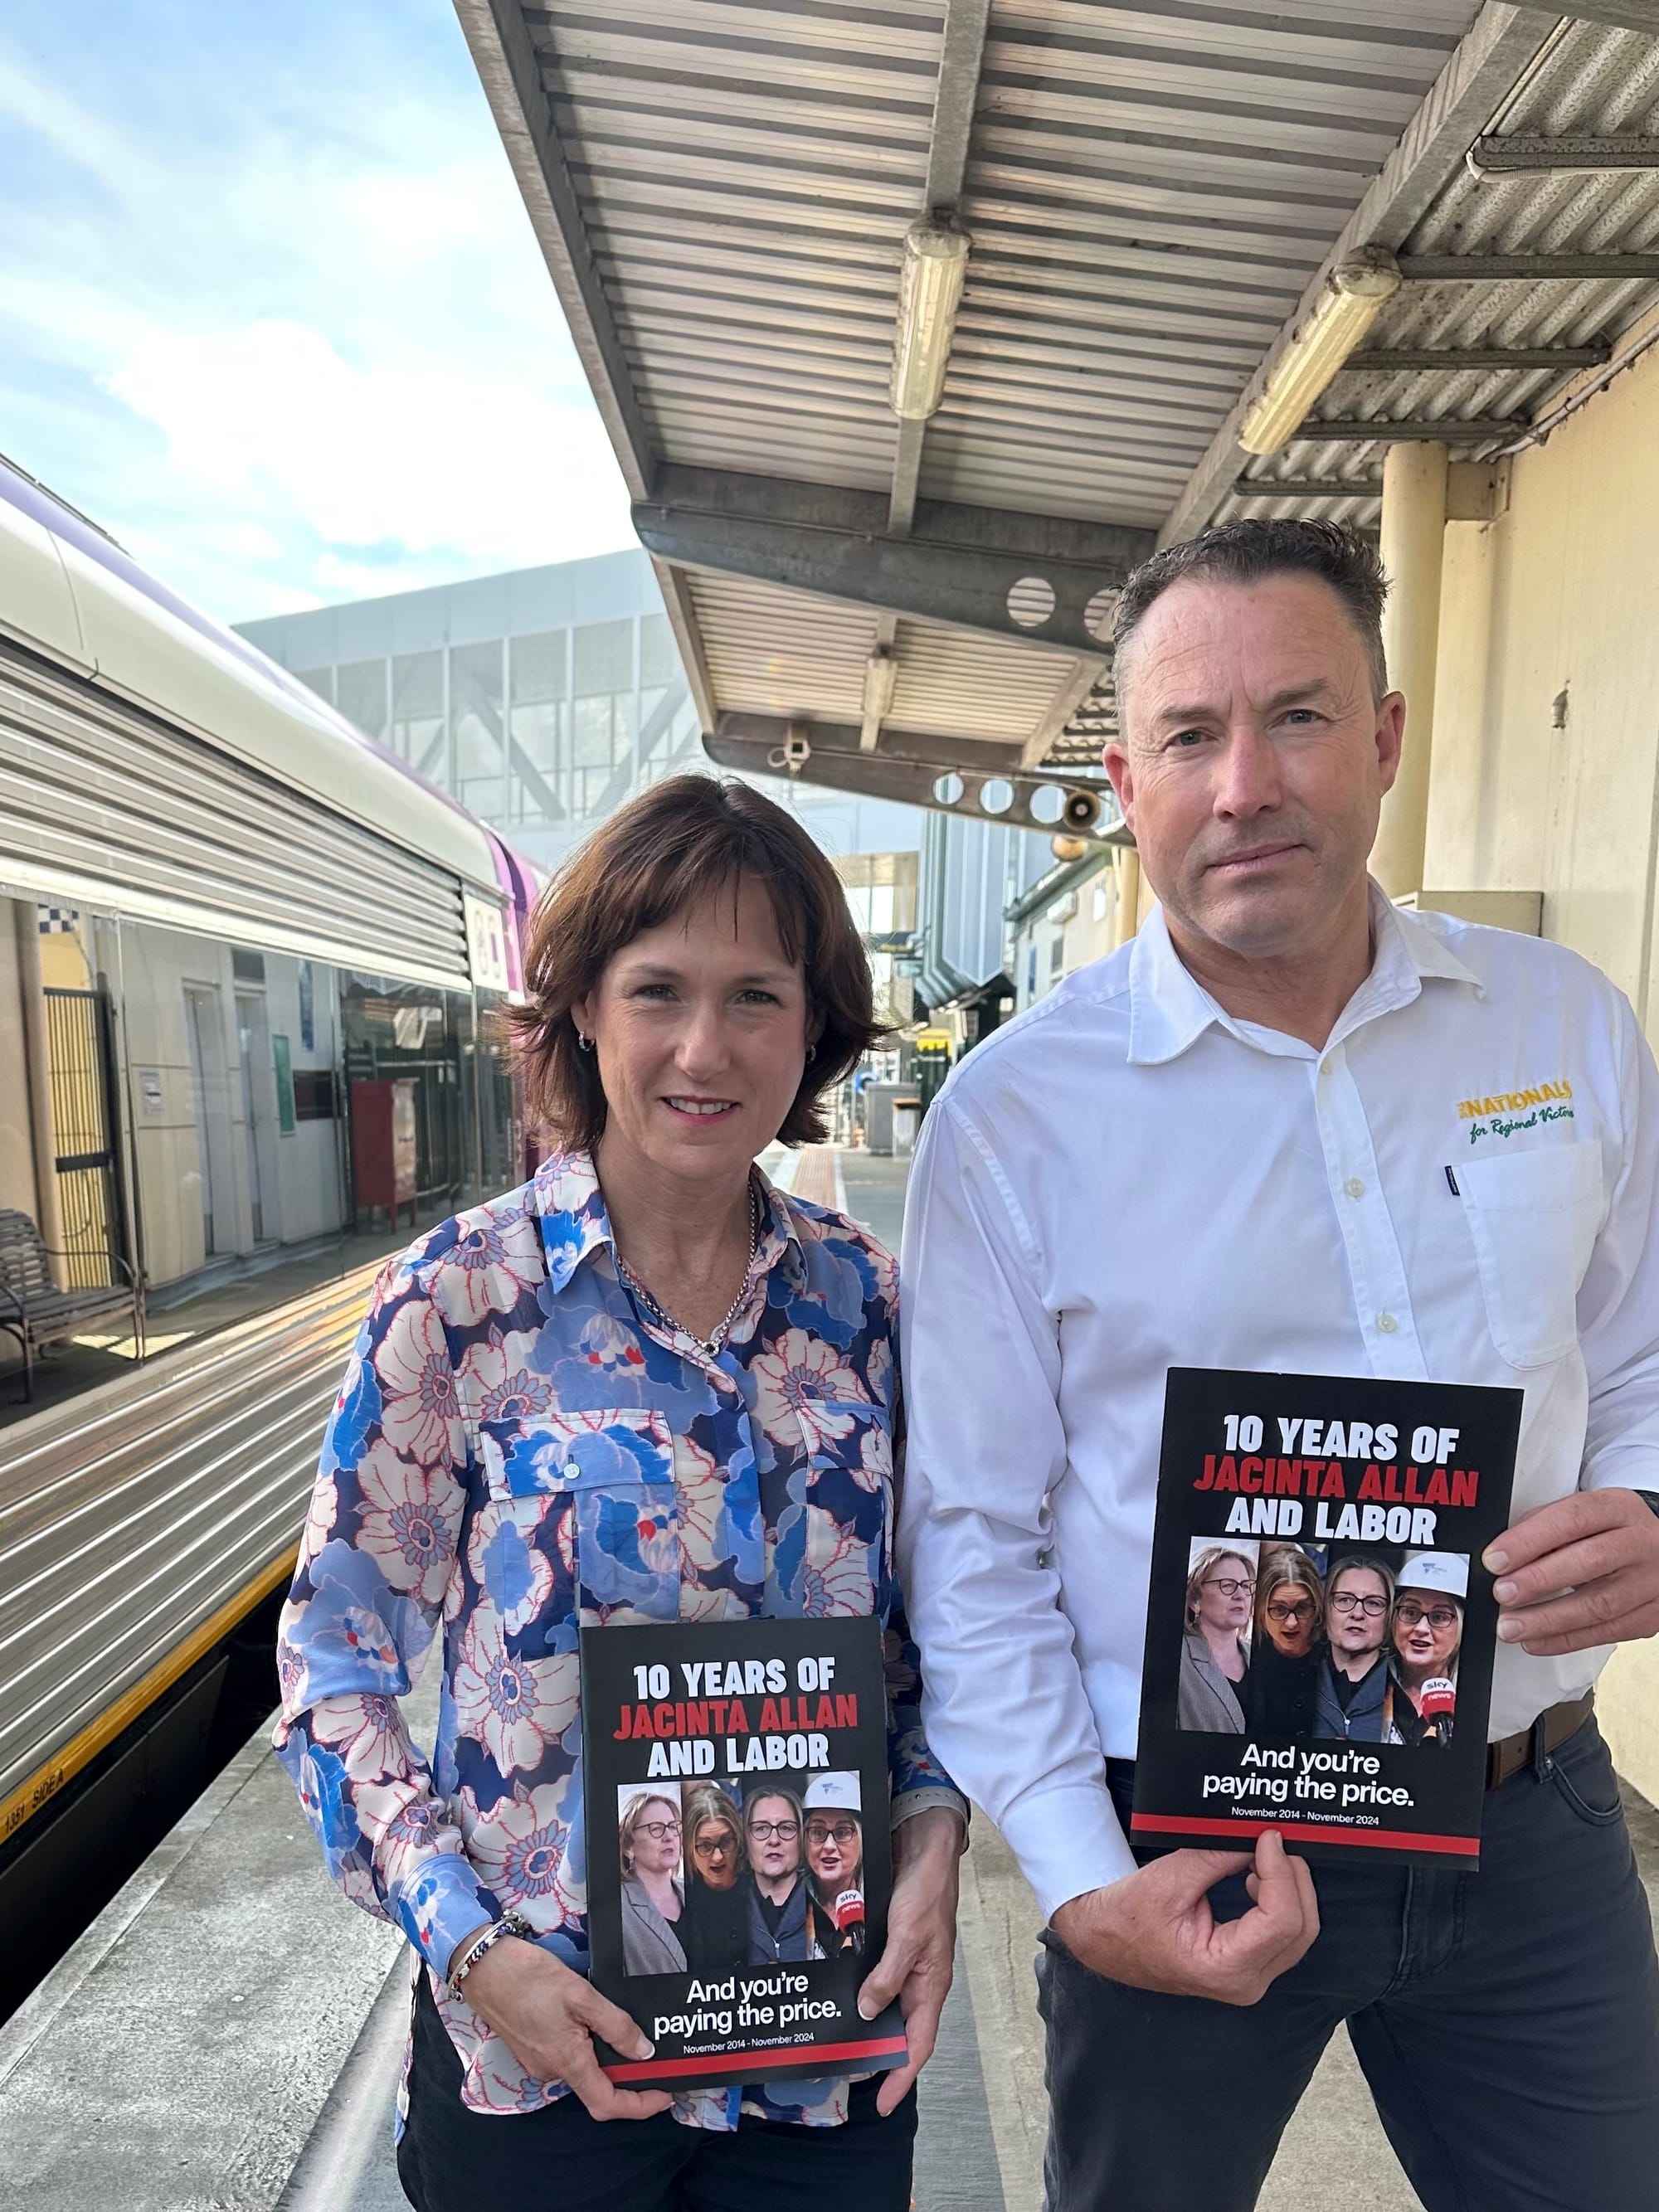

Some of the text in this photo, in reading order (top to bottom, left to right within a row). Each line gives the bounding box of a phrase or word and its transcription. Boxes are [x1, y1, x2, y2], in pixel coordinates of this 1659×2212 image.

[1470, 1123, 1488, 1145] for
[1491, 1112, 1538, 1138] Regional
[1224, 1414, 1460, 1465] 10 YEARS OF
[1194, 1455, 1479, 1507] JACINTA ALLAN
[1224, 1496, 1438, 1545] AND LABOR
[633, 1656, 835, 1700] 10 YEARS OF
[614, 1694, 858, 1740] JACINTA ALLAN
[646, 1733, 830, 1777] AND LABOR
[1239, 1743, 1380, 1776] And you're
[32, 1773, 56, 1809] SIDE
[56, 1767, 64, 1787] A
[1202, 1772, 1414, 1807] paying the price.
[1231, 1806, 1278, 1818] November
[1278, 1809, 1301, 1819] 2014
[1306, 1811, 1355, 1824] November
[1355, 1815, 1379, 1826] 2024
[686, 1971, 809, 2005] And you're
[654, 1997, 842, 2041] paying the price.
[683, 2043, 726, 2054] November
[727, 2039, 746, 2050] 2014
[751, 2035, 793, 2047] November
[793, 2032, 815, 2043] 2024
